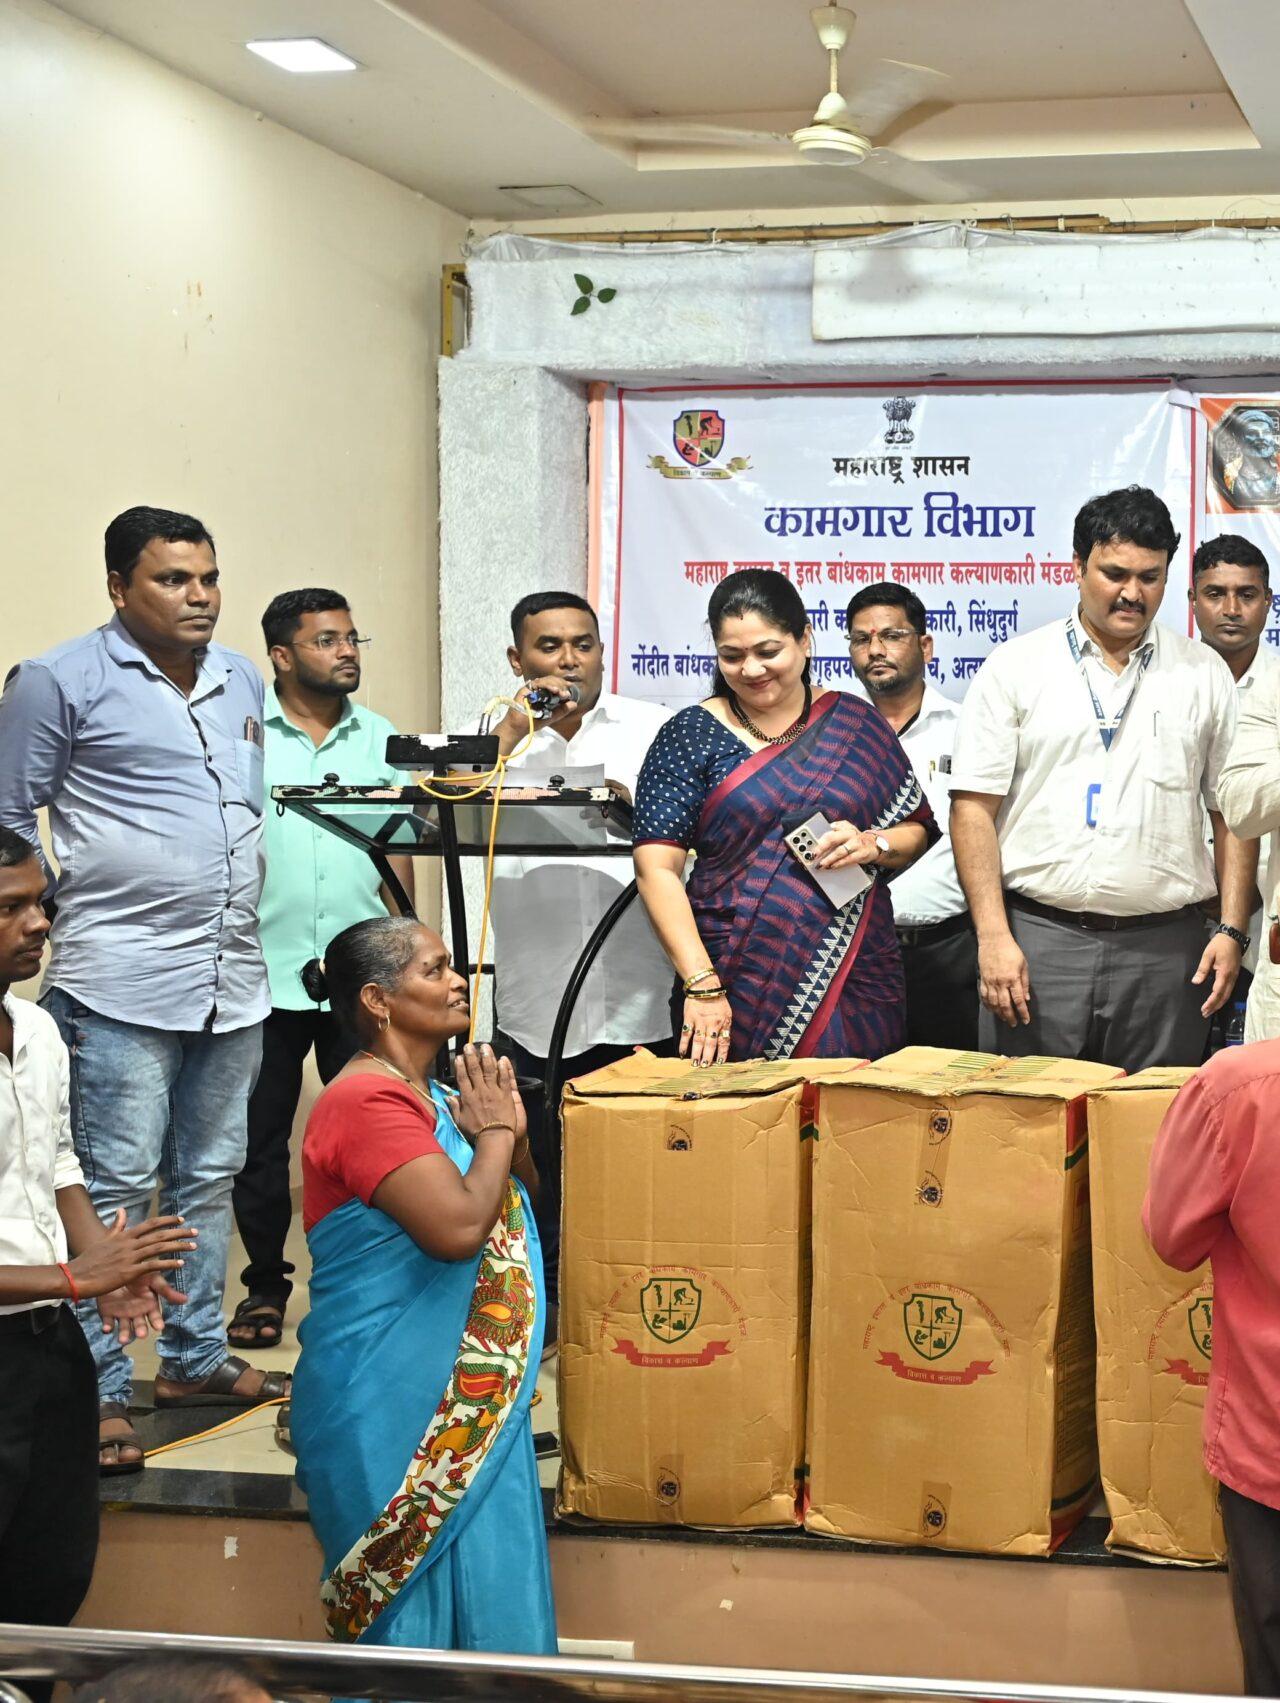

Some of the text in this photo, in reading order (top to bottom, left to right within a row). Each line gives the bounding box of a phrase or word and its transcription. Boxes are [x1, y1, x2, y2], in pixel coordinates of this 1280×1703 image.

[832, 455, 970, 485] महाराष्ट्र शासन
[764, 491, 1037, 538] कामगार विभाग
[795, 561, 822, 592] इतर
[827, 551, 886, 584] बांधकाम
[891, 561, 945, 586] कामगार
[950, 552, 1036, 586] कल्याणकारी
[967, 598, 1018, 644] सिंधुदुर्ग
[630, 643, 670, 679] नोंदीत
